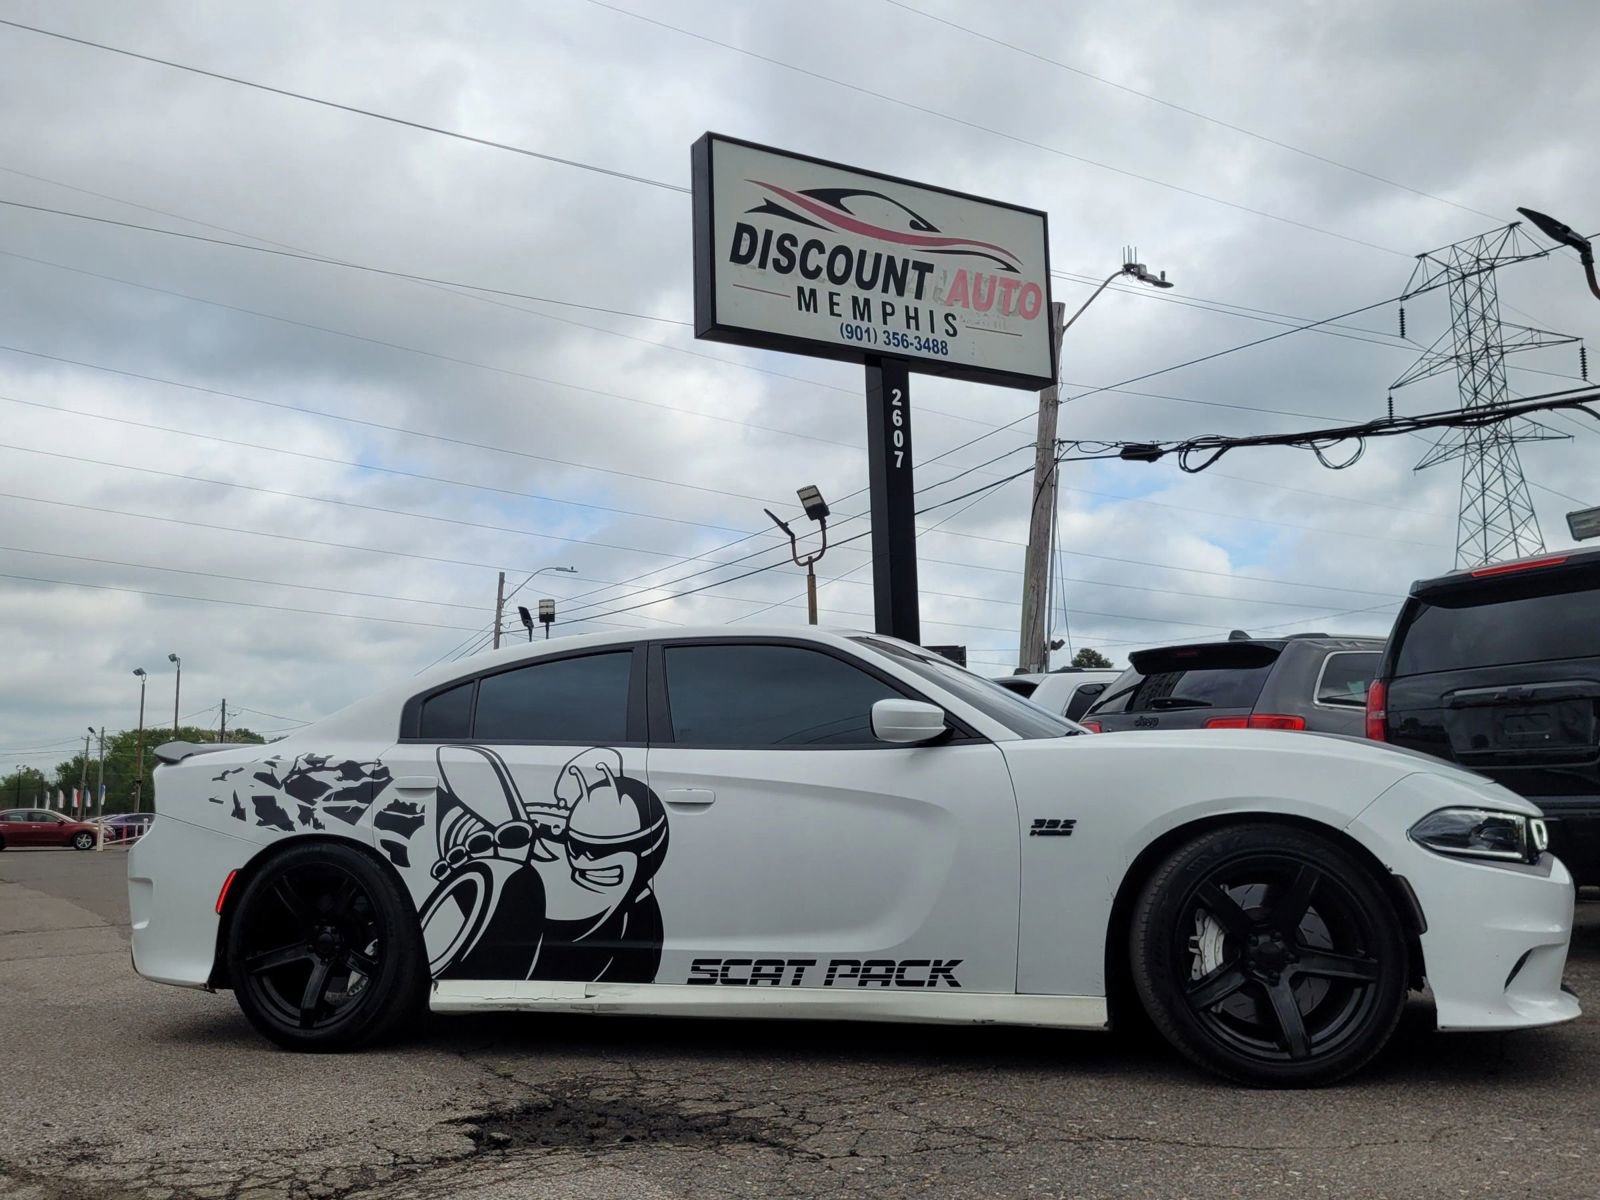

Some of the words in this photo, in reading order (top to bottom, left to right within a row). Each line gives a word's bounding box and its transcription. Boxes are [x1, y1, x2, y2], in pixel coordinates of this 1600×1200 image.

[729, 222, 934, 300] DISCOUNT
[945, 269, 1042, 320] AUTO
[796, 286, 958, 337] MEMPHIS
[839, 322, 878, 344] (901)
[882, 330, 949, 356] 356-3488
[891, 388, 904, 468] 2607
[686, 958, 817, 986] SCAT
[823, 959, 964, 988] PACK
